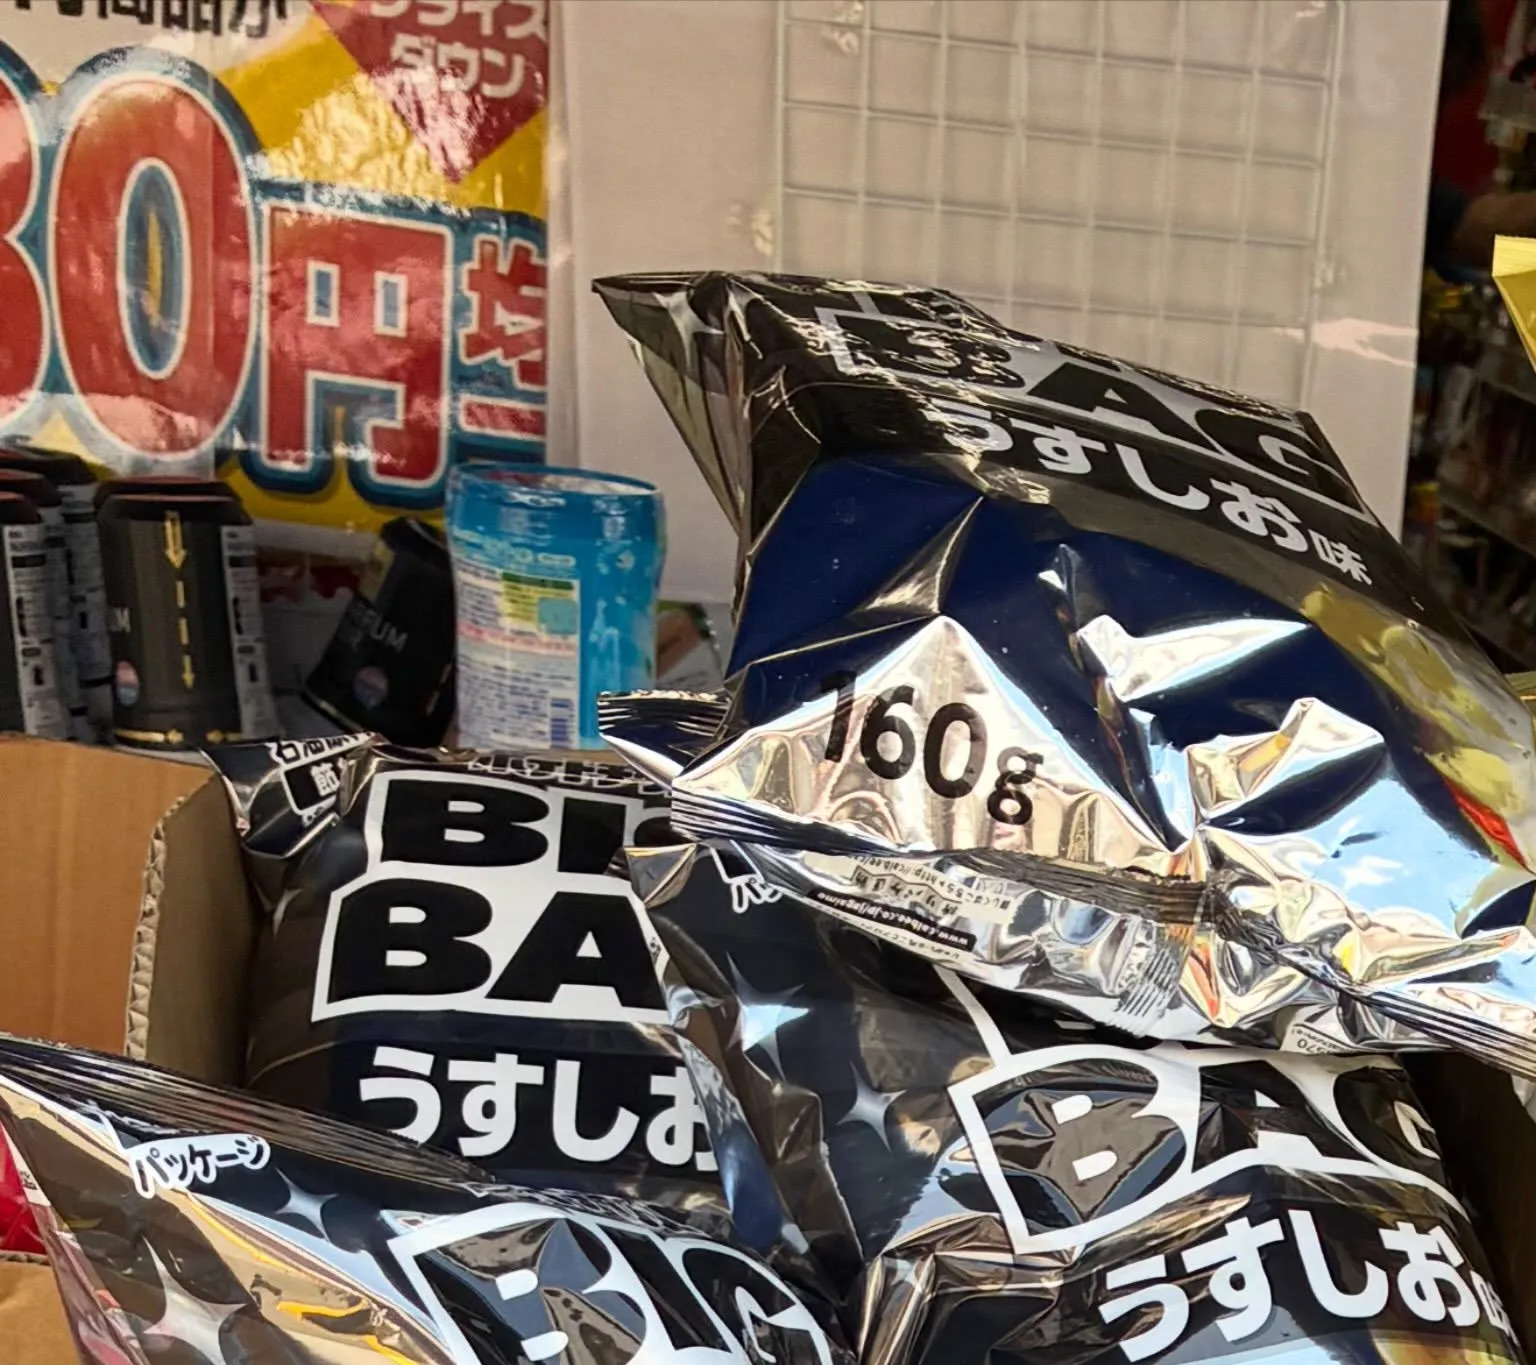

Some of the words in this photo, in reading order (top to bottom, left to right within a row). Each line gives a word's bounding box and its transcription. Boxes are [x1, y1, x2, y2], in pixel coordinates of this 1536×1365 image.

[943, 402, 1374, 588] うすしお味
[820, 668, 1045, 827] 160g
[380, 782, 672, 875] BI
[328, 878, 643, 1003] BA
[133, 1134, 270, 1197] パッケージ
[358, 1045, 724, 1173] うすしお
